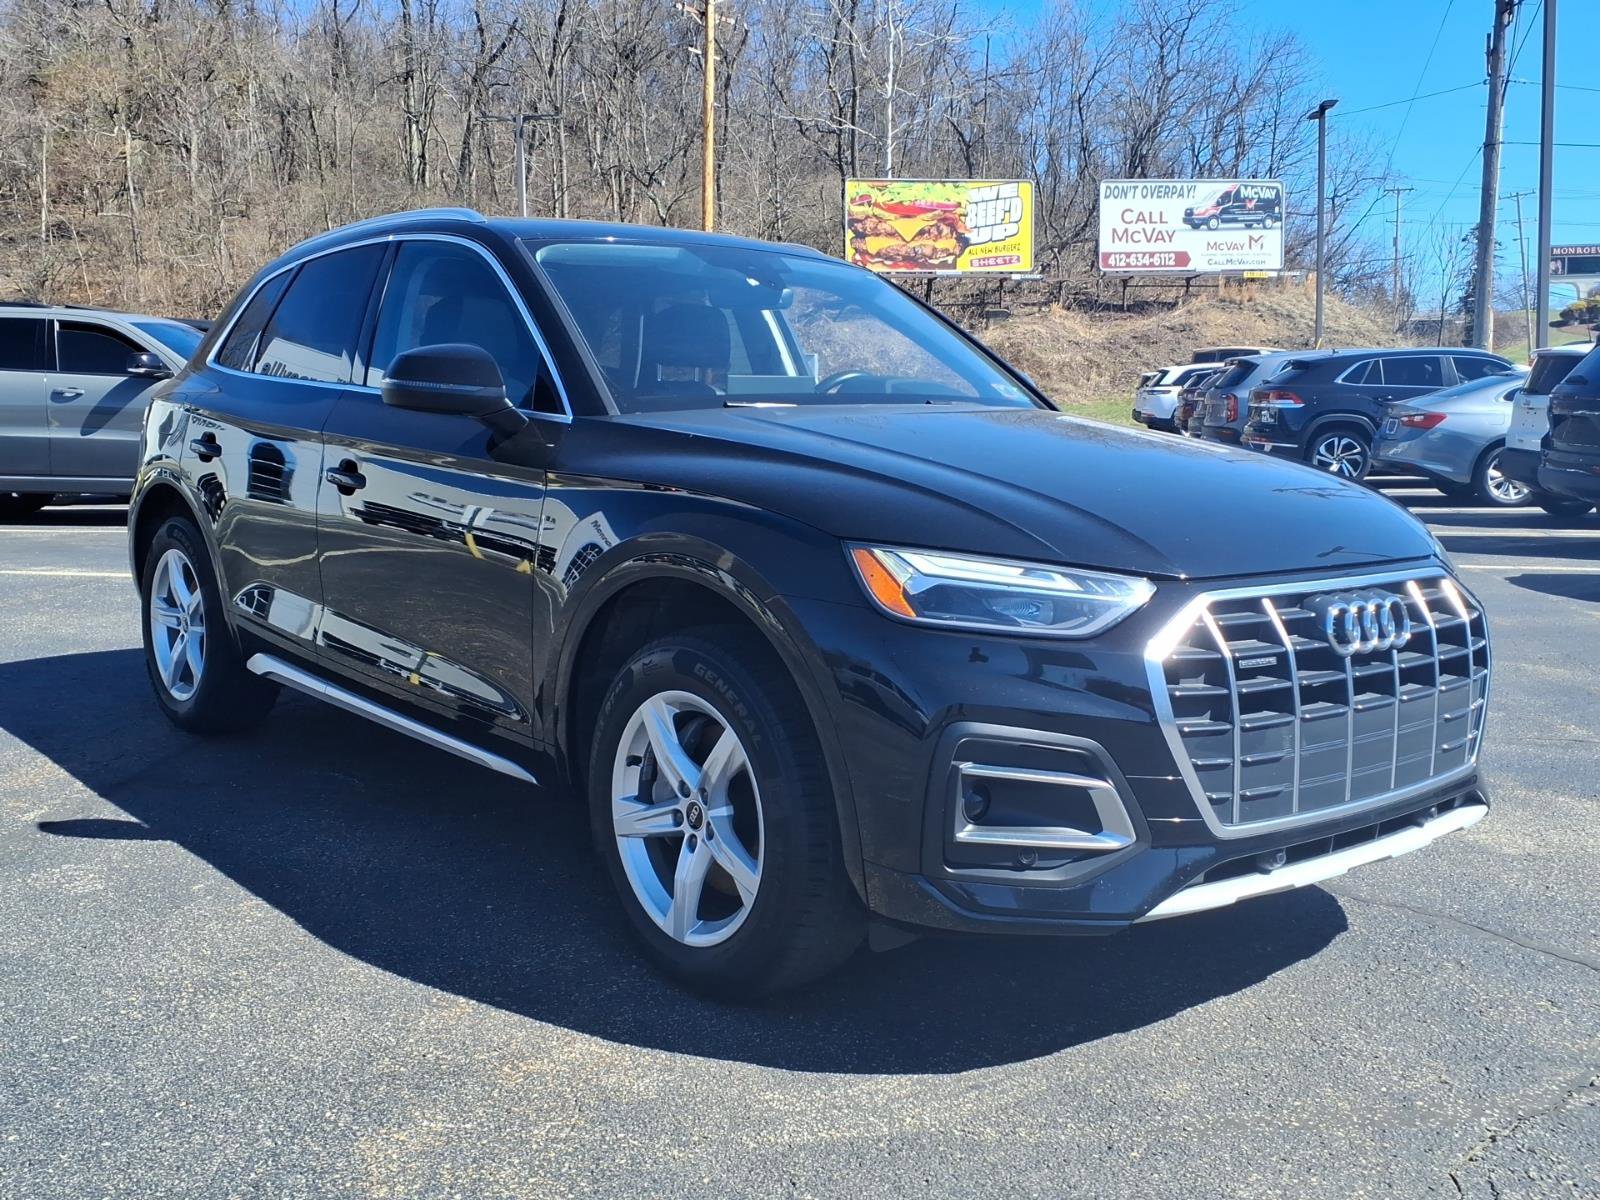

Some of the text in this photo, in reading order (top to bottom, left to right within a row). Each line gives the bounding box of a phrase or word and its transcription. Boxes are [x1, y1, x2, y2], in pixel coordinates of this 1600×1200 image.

[1104, 185, 1196, 199] DON'T OVERPAY!
[965, 197, 1023, 229] BEEF'D
[1121, 208, 1168, 224] CALL
[965, 223, 1019, 246] UP
[968, 248, 978, 256] ALL
[980, 247, 992, 255] NEW
[1108, 252, 1175, 266] 412-634-6112
[971, 256, 1019, 267] SHEETZ
[693, 662, 761, 751] GENERAL
